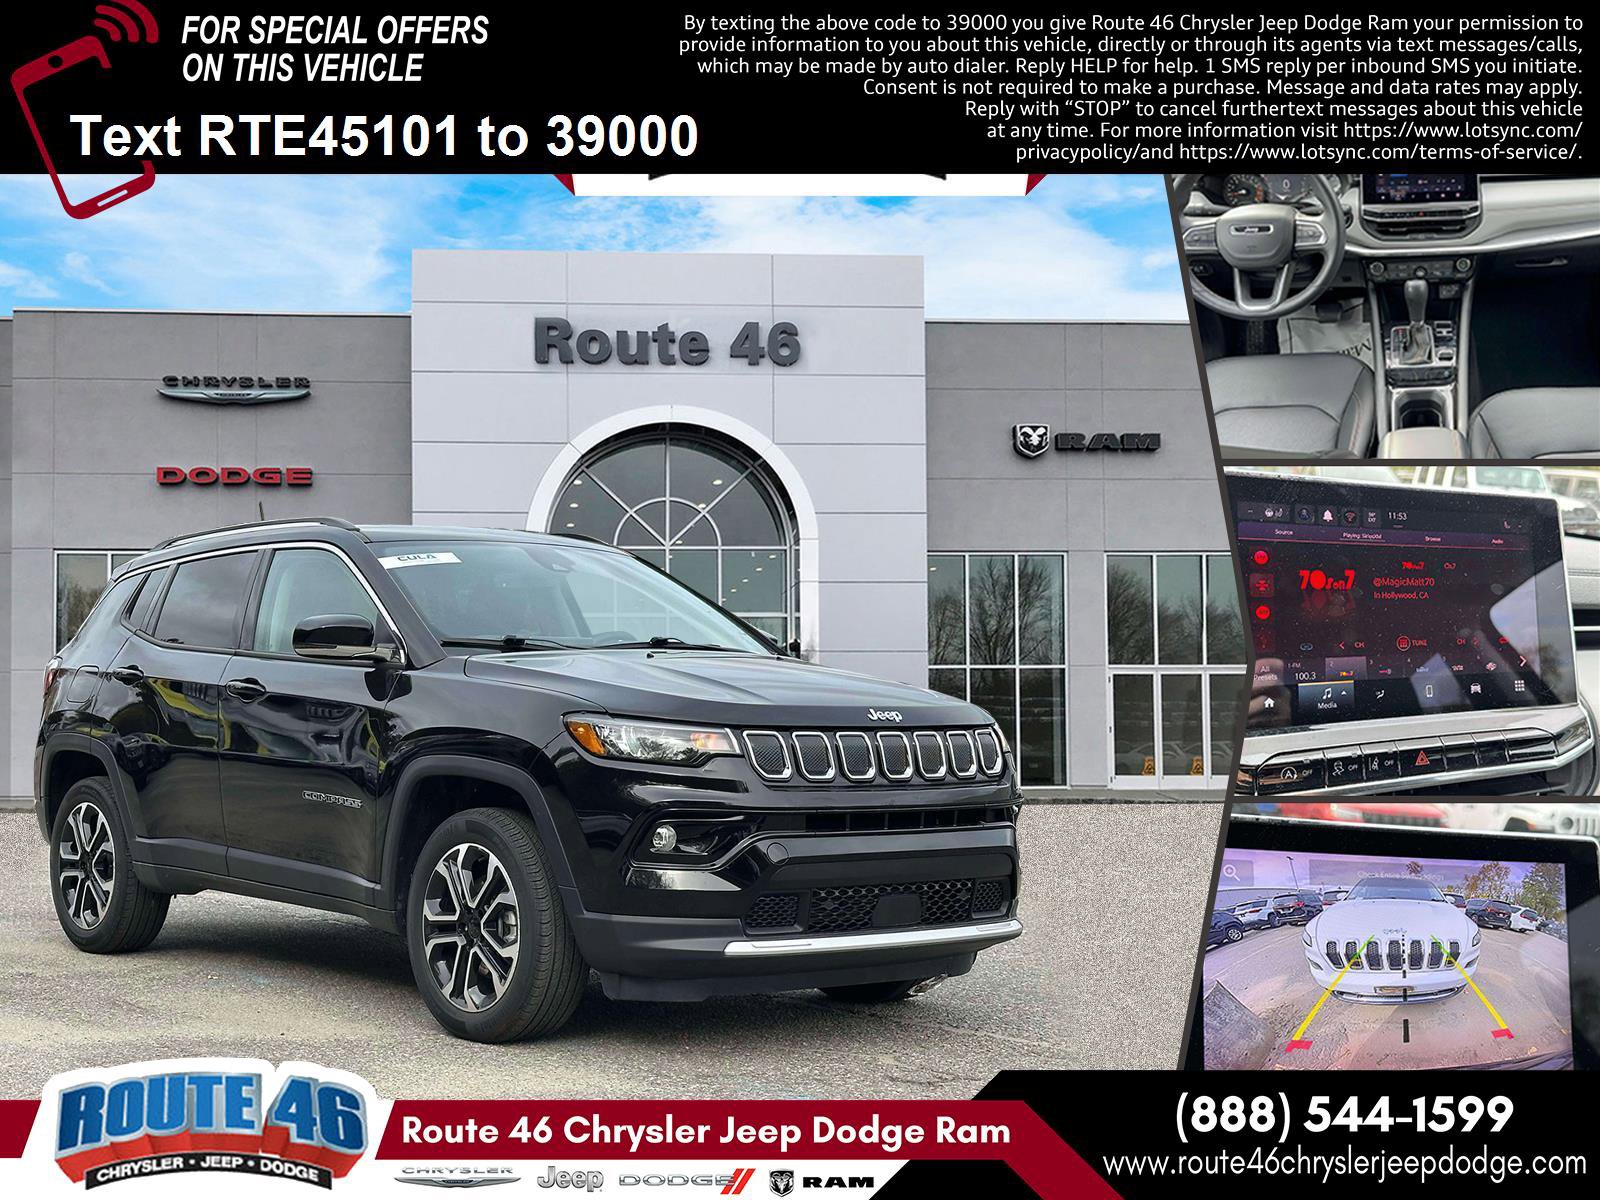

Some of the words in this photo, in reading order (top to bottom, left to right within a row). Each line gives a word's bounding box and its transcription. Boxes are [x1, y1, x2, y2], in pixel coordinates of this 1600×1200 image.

[534, 316, 711, 367] Route
[729, 320, 802, 367] 46
[162, 375, 311, 388] CHRYSLER
[1055, 432, 1161, 452] RAM
[156, 466, 313, 486] DODGE
[1387, 511, 1408, 521] 11:53
[1373, 577, 1436, 588] @MagicMatt70
[1295, 671, 1317, 681] 100.3
[1317, 701, 1338, 710] Media
[867, 708, 903, 723] Jeep
[302, 790, 363, 809] COMPASS
